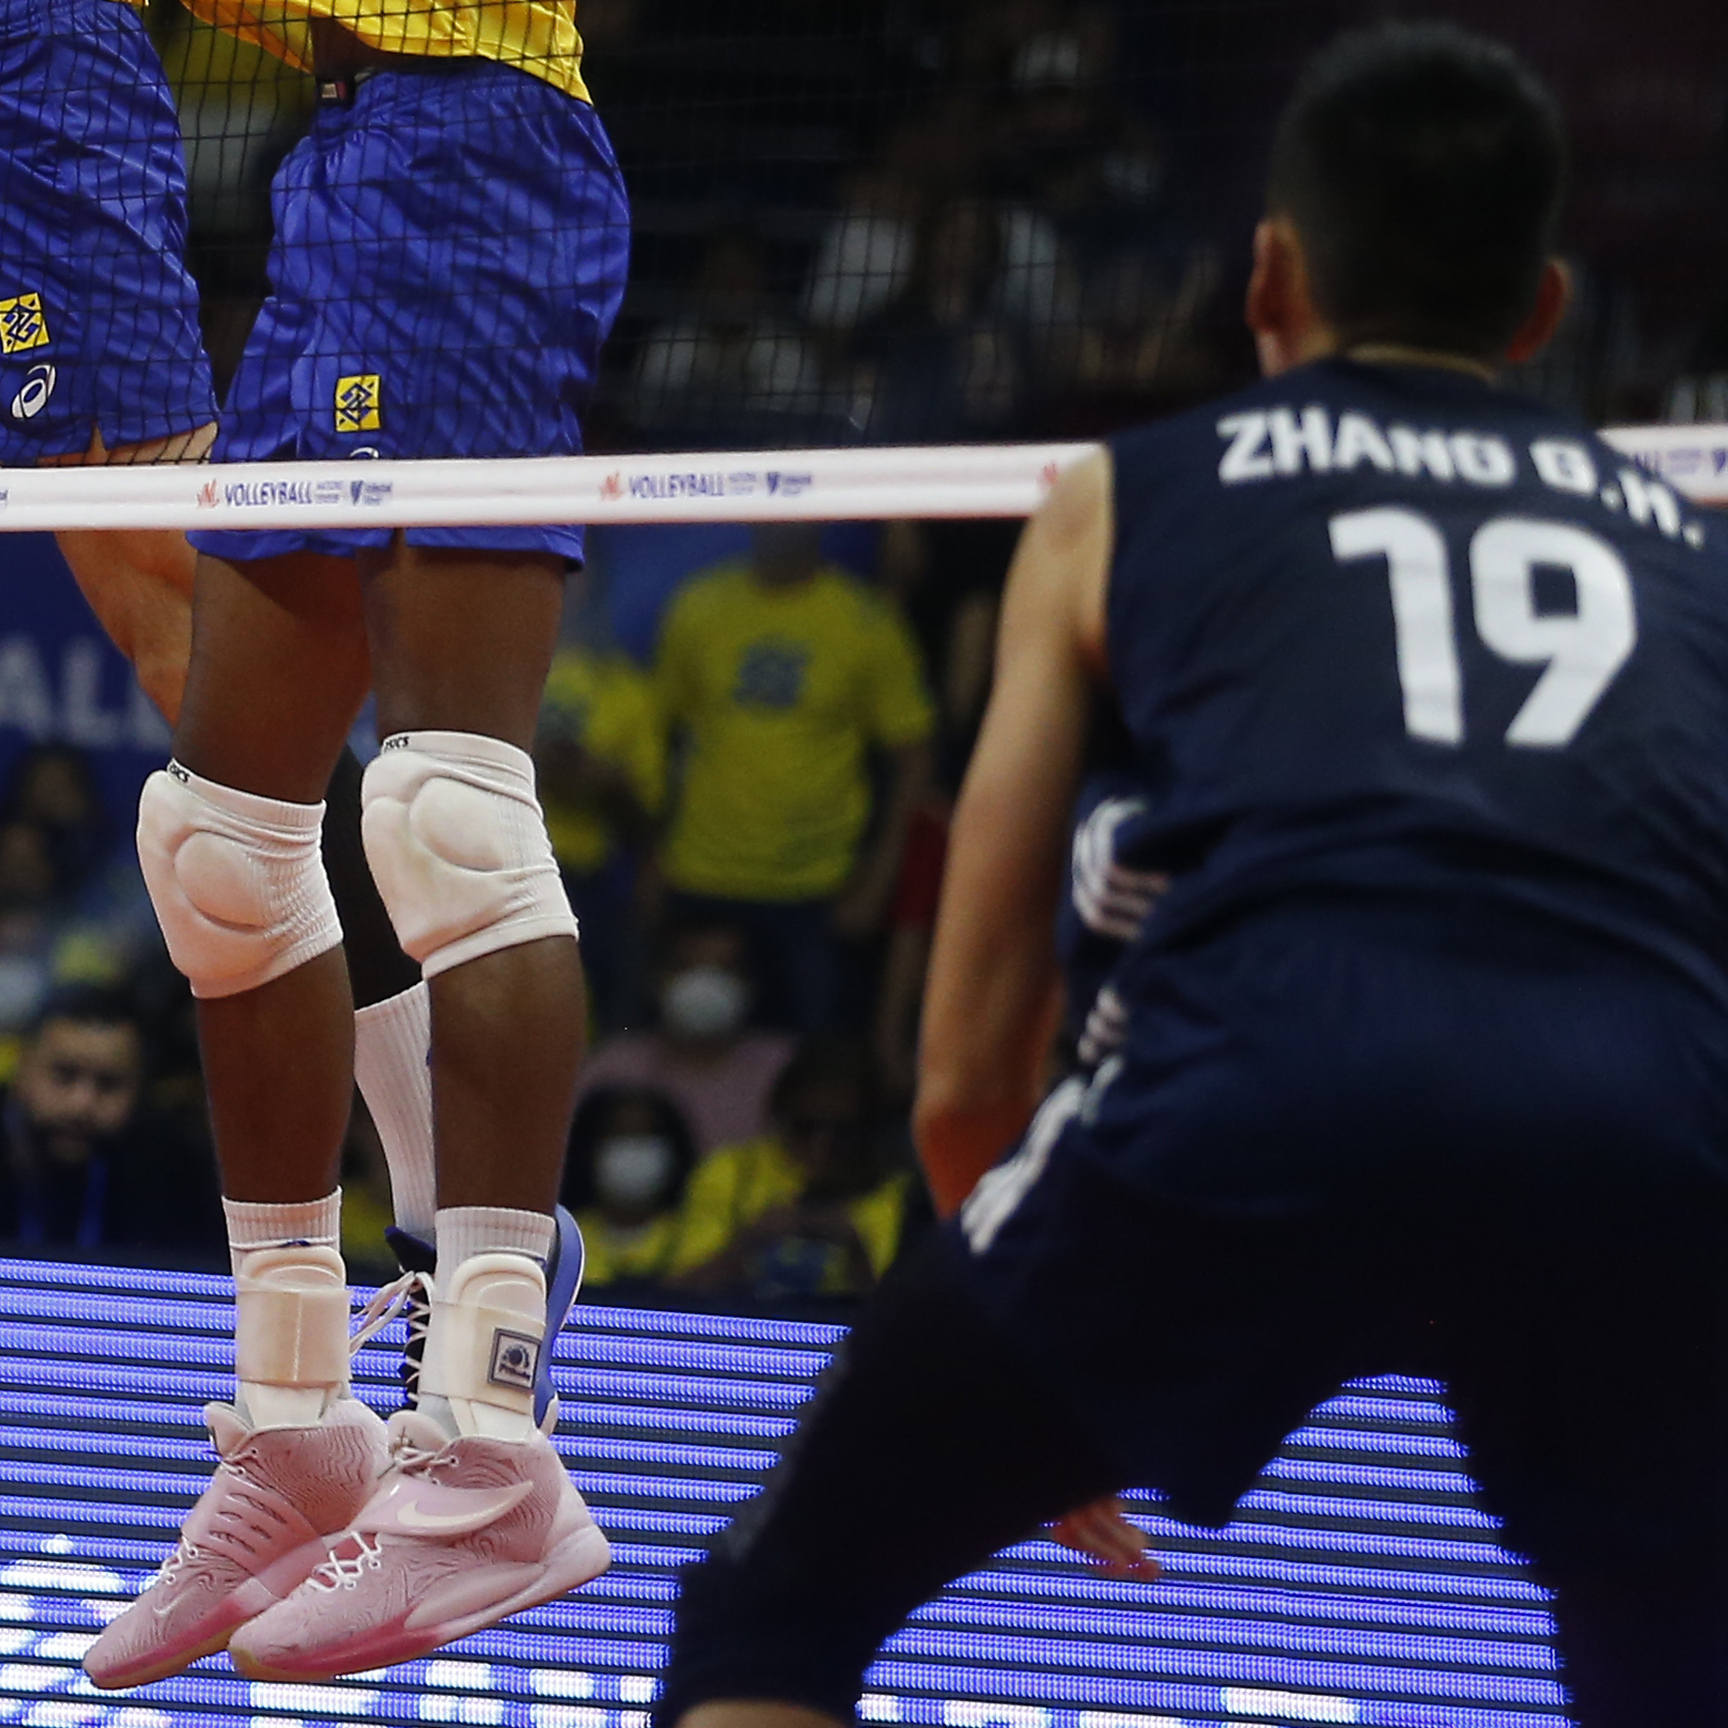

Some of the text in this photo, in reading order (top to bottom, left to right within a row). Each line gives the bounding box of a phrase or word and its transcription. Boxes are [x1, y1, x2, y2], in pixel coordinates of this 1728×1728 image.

[1216, 403, 1518, 488] ZHANG
[224, 481, 313, 506] VOLLEYBALL
[627, 472, 726, 499] VOLLEYBALL
[1327, 504, 1638, 750] 19
